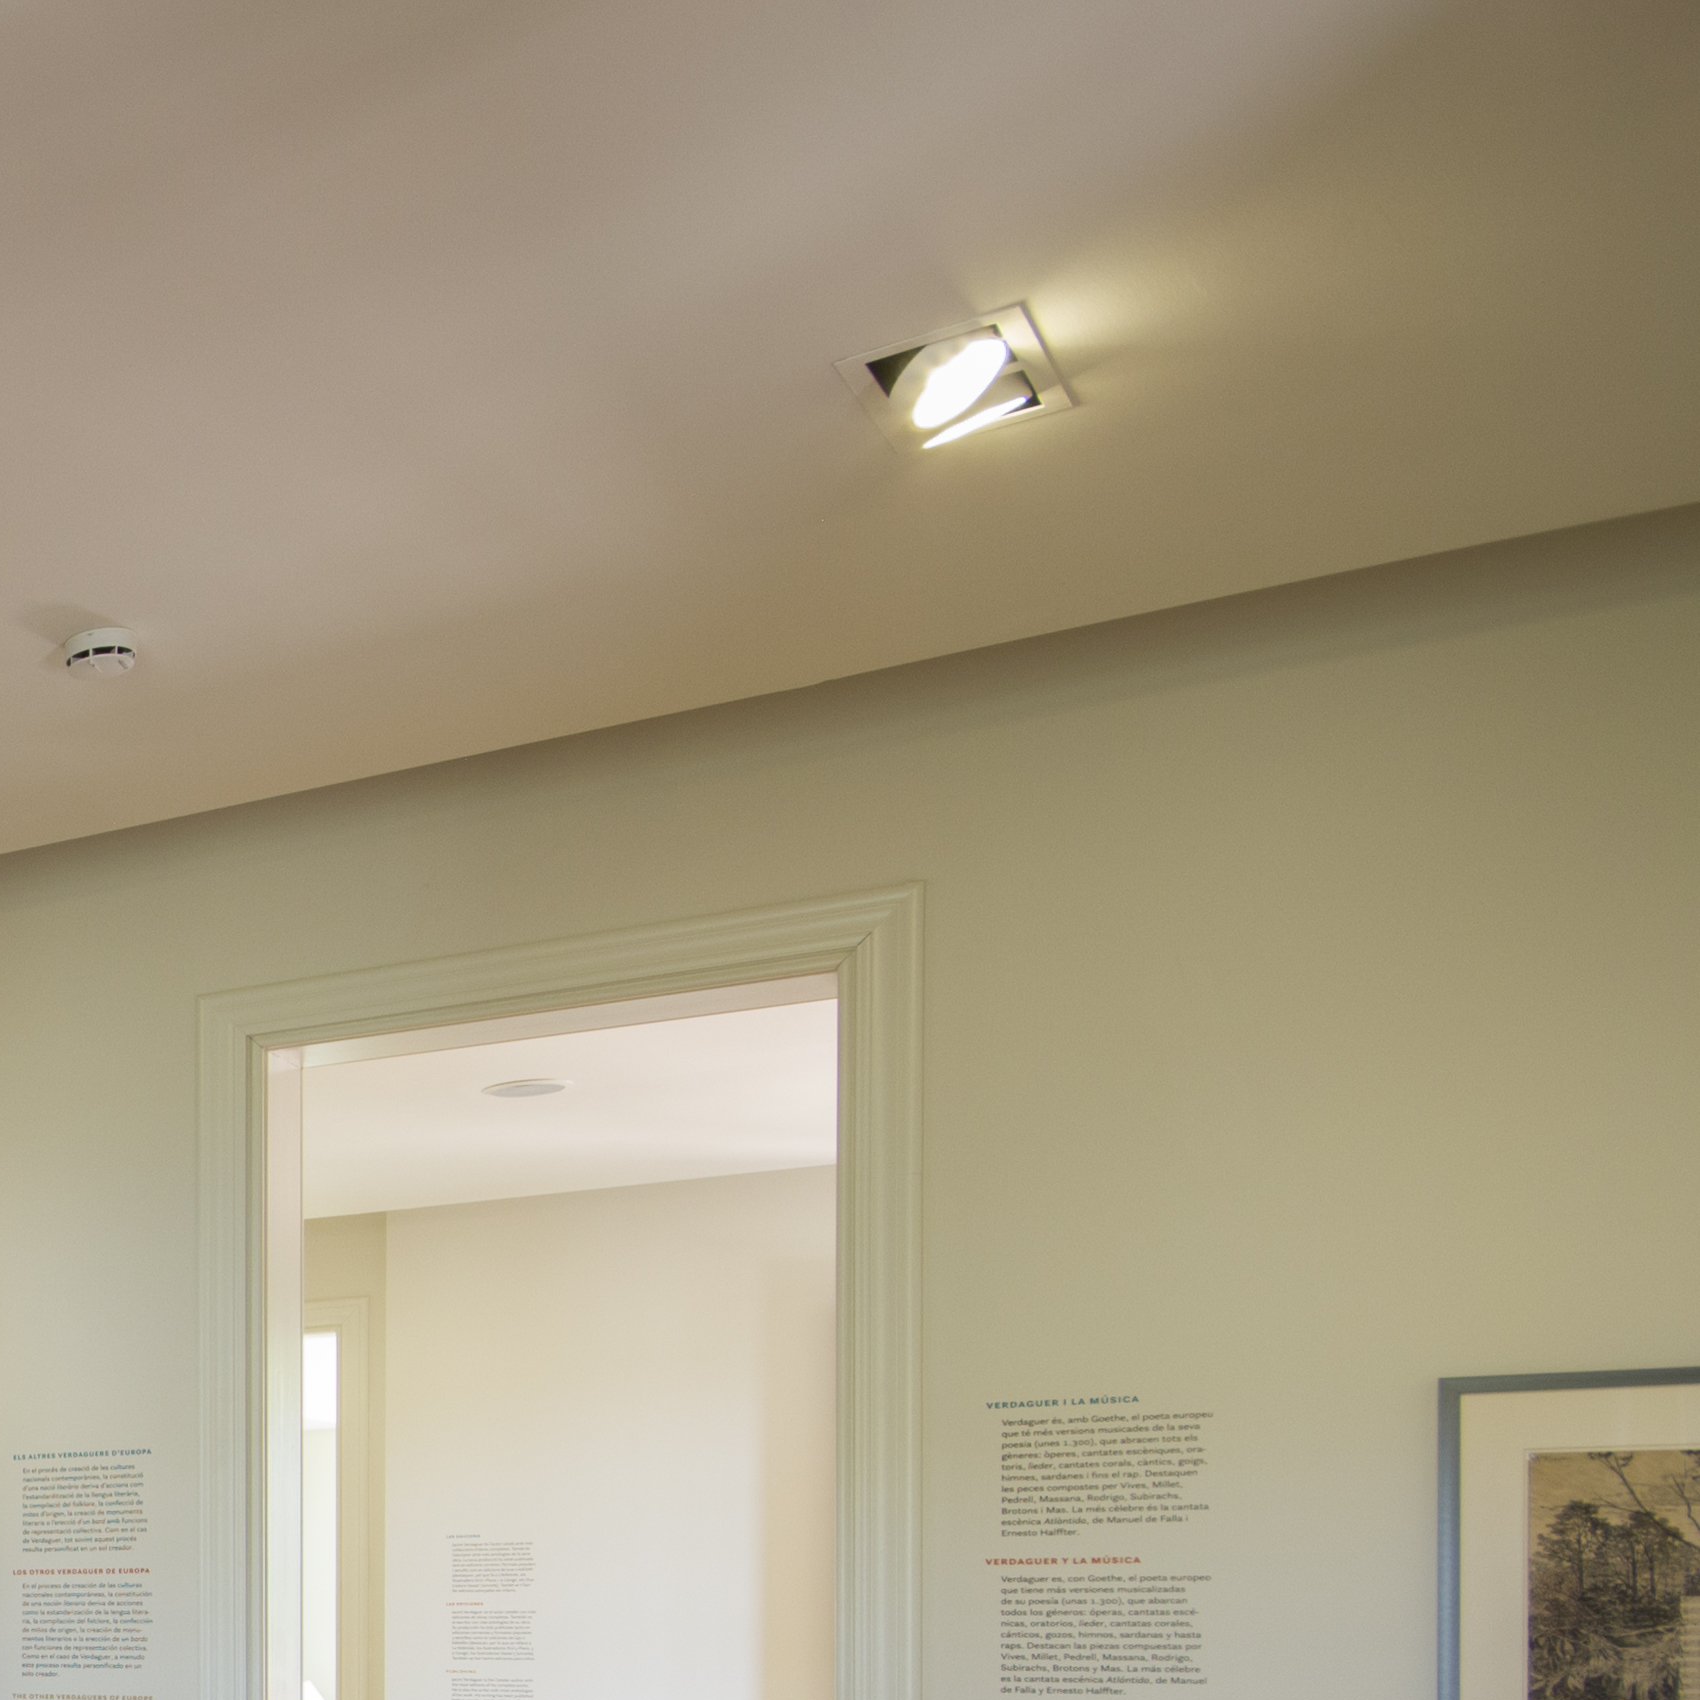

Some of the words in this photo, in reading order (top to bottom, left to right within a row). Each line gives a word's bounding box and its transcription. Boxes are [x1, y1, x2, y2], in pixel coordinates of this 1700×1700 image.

[986, 1399, 1060, 1410] VERDAGUER
[1089, 1395, 1140, 1405] MÚSICA
[1001, 1418, 1050, 1428] Verdaguer
[1090, 1414, 1129, 1424] Goethe,
[1141, 1413, 1171, 1422] poeta
[1172, 1412, 1214, 1420] europeu
[1000, 1431, 1020, 1439] que
[1055, 1428, 1096, 1436] versions
[1097, 1426, 1150, 1435] musicades
[1000, 1442, 1032, 1450] poesia
[1033, 1440, 1060, 1449] (unes
[1099, 1438, 1118, 1446] que
[1119, 1437, 1160, 1445] abracen
[1161, 1435, 1182, 1444] tots
[1000, 1452, 1042, 1461] gèneres:
[1043, 1451, 1079, 1459] òperes,
[1081, 1449, 1124, 1458] cantates
[1125, 1447, 1183, 1456] escèniques,
[1001, 1464, 1026, 1472] toris,
[1058, 1461, 1100, 1470] cantates
[1101, 1460, 1134, 1468] corals,
[1136, 1459, 1175, 1467] càntics,
[1177, 1458, 1207, 1467] goigs,
[1000, 1475, 1038, 1483] himnes,
[1040, 1473, 1085, 1481] sardanes
[1091, 1472, 1110, 1480] fins
[1122, 1471, 1141, 1479] rap.
[1144, 1469, 1198, 1478] Destaquen
[985, 1557, 1058, 1565] VERDAGUER
[1090, 1556, 1141, 1564] MÚSICA
